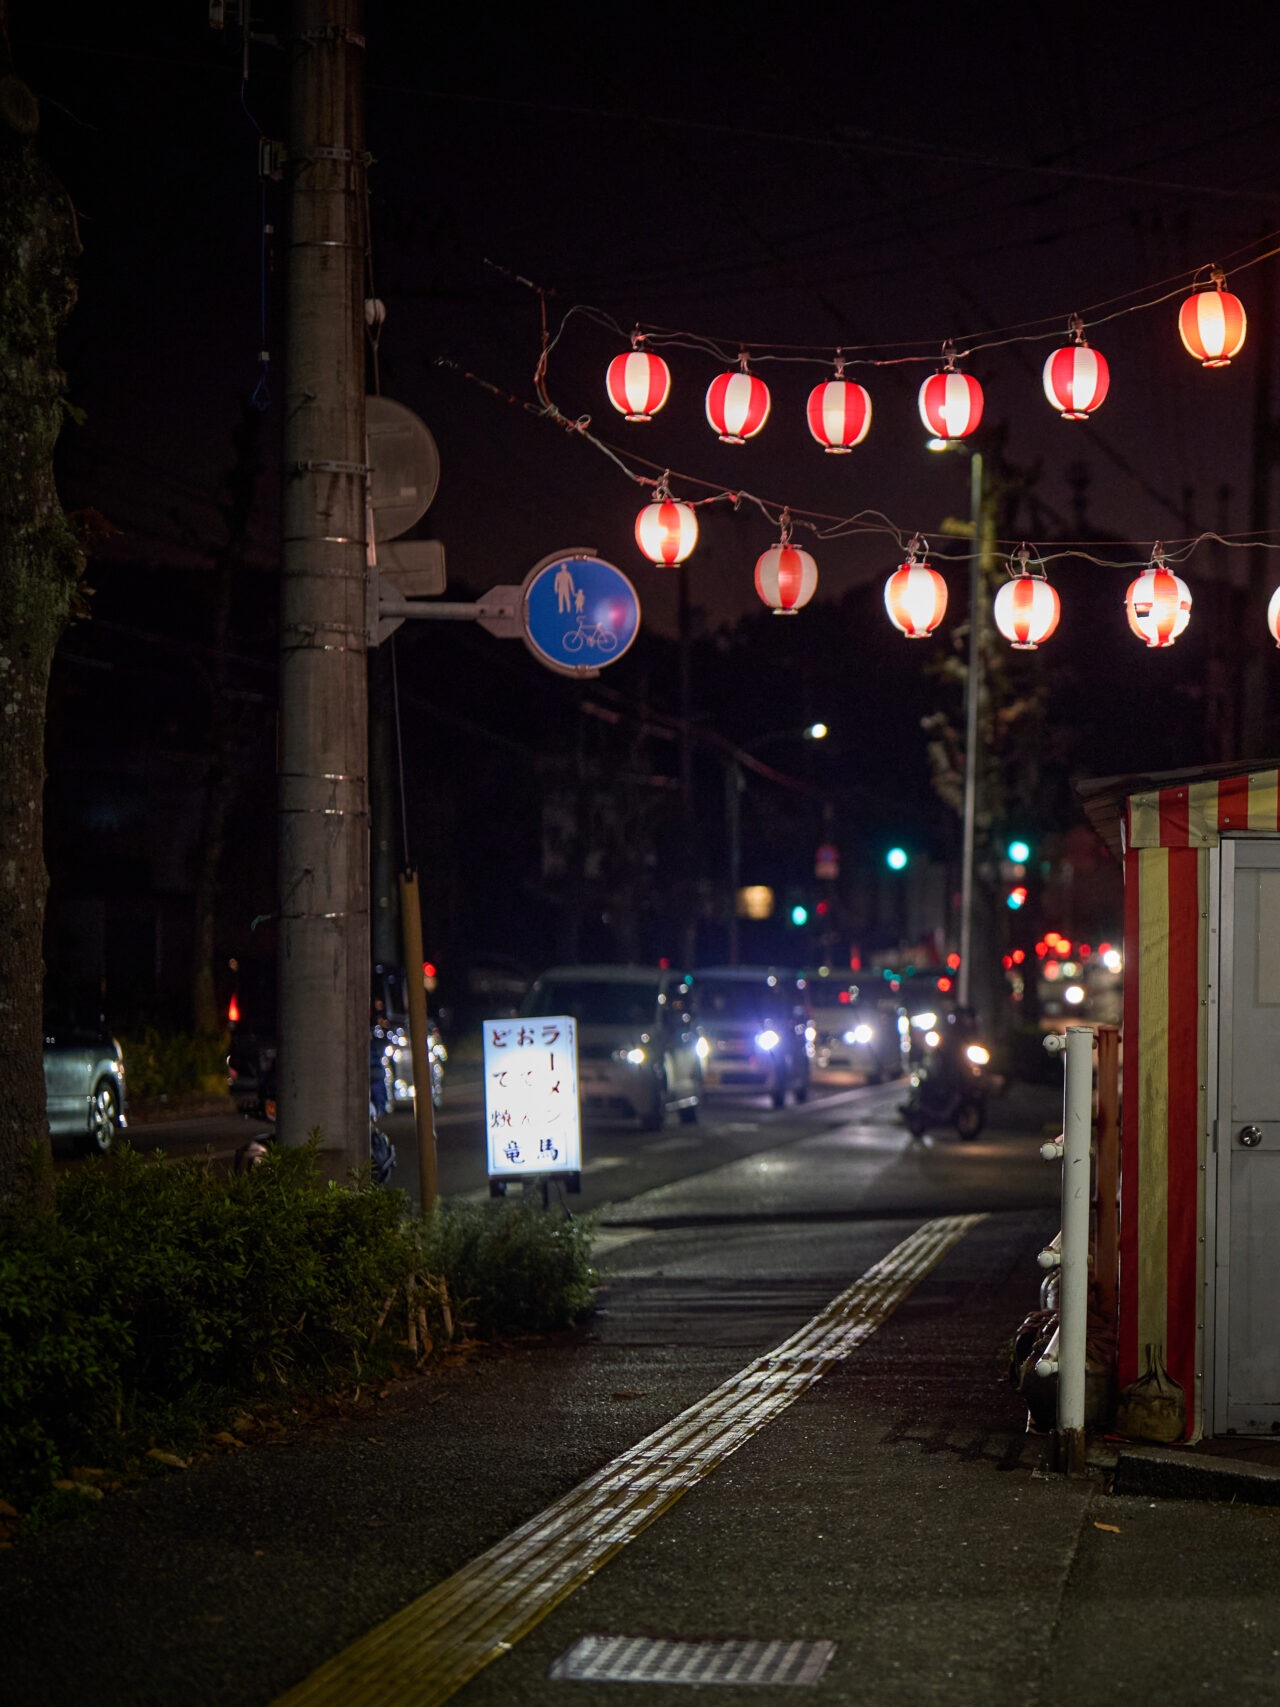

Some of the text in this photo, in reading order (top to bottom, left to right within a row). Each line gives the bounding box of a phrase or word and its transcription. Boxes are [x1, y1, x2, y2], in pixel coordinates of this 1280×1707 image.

[491, 1028, 512, 1128] どて焼
[503, 1138, 559, 1164] 竜馬
